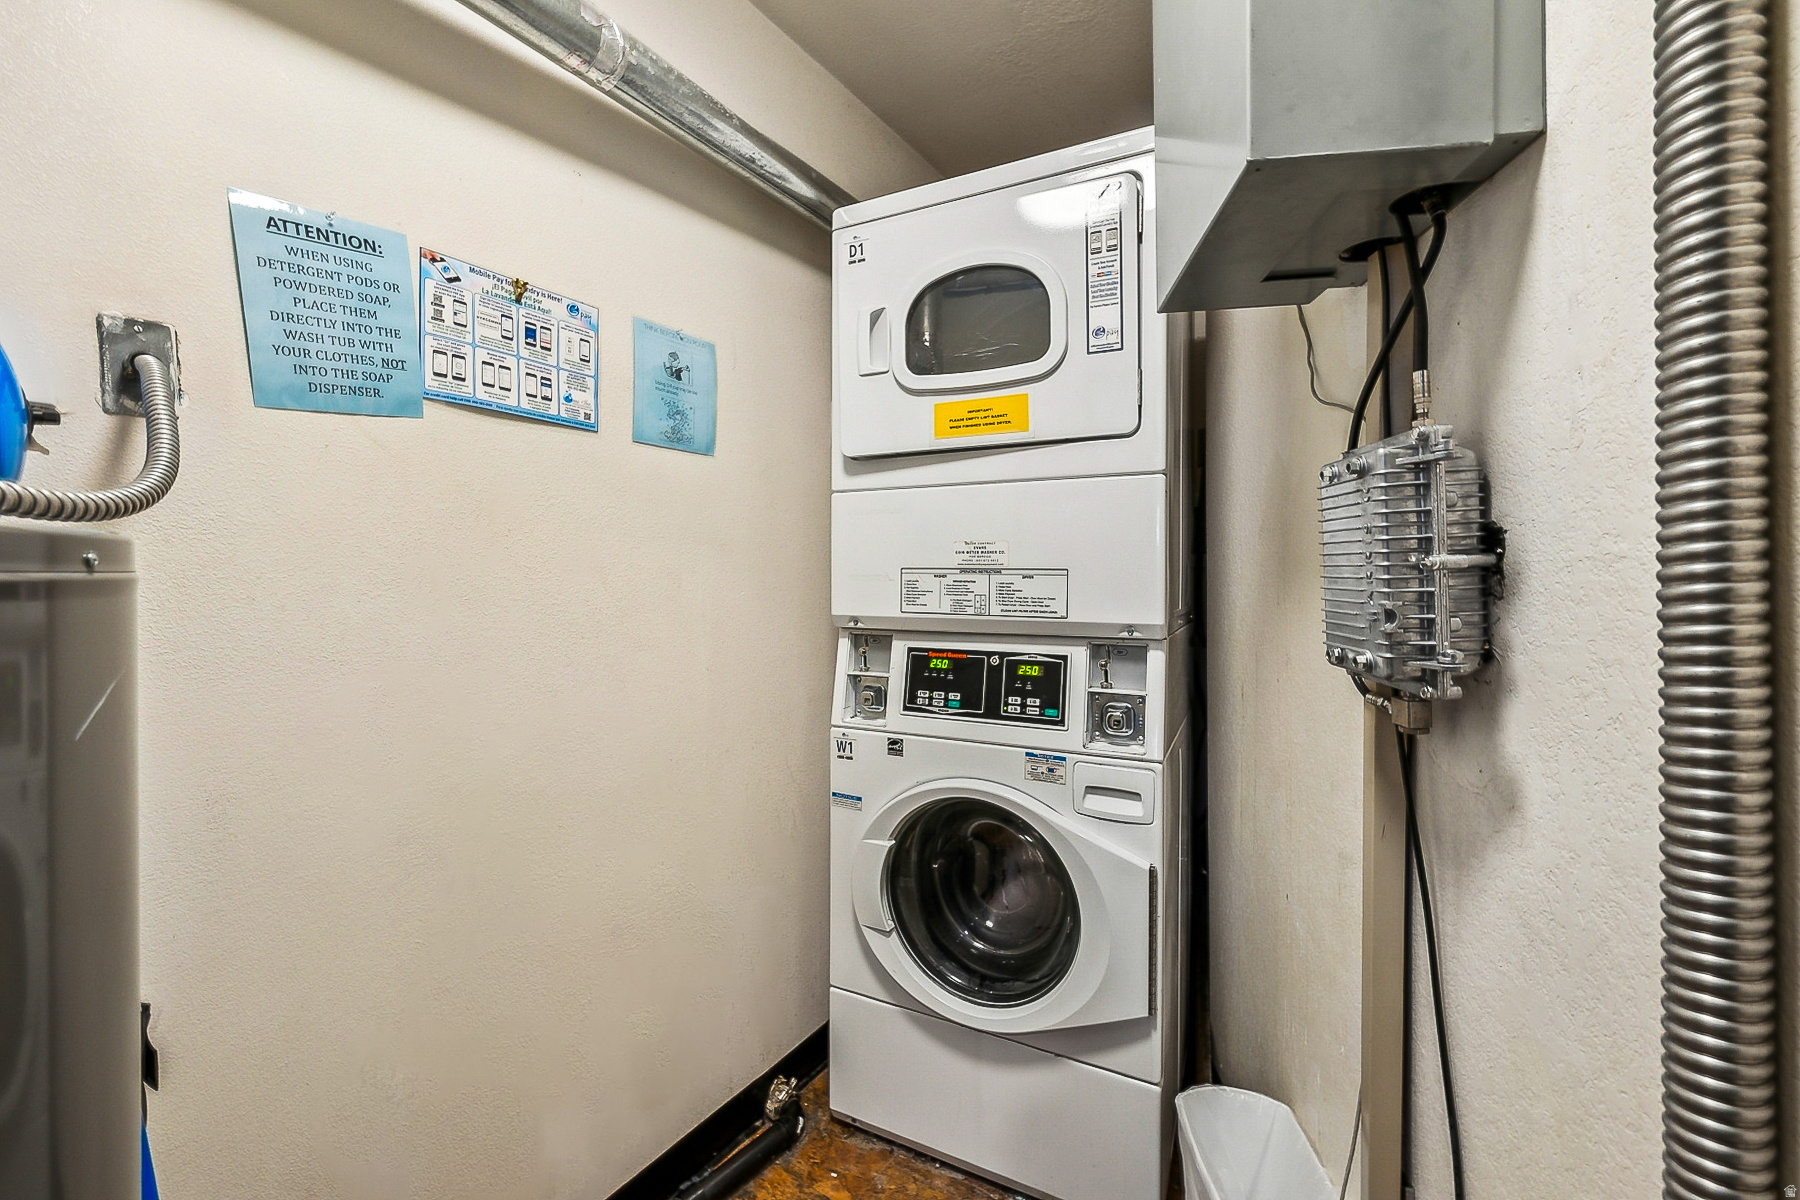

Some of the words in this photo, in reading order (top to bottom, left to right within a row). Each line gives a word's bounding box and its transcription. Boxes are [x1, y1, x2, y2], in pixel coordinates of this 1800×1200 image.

[266, 216, 384, 255] ATTENTION:
[284, 245, 329, 266] WHEN
[333, 256, 373, 272] USING
[849, 242, 863, 258] D1
[256, 256, 343, 282] DETERGENT
[347, 274, 380, 290] PODS
[383, 282, 401, 294] OR
[469, 266, 491, 280] Mobile
[492, 274, 504, 286] Pay
[548, 293, 562, 304] Here!
[273, 276, 354, 300] POWDERED
[357, 292, 392, 308] SOAP,
[481, 287, 489, 296] La
[293, 297, 337, 314] PLACE
[340, 305, 378, 320] THEM
[269, 310, 338, 330] DIRECTLY
[341, 321, 373, 335] INTO
[375, 327, 402, 340] THE
[283, 328, 325, 345] WASH
[328, 336, 356, 348] TUB
[358, 340, 394, 354] WITH
[272, 345, 312, 360] YOUR
[315, 350, 378, 368] CLOTHES,
[381, 358, 407, 372] NOT
[293, 364, 328, 378] INTO
[331, 368, 358, 381] THE
[361, 371, 394, 384] SOAP
[308, 382, 384, 398] DISPENSER.
[930, 659, 948, 668] 250
[1018, 665, 1039, 676] 250
[836, 740, 853, 754] W1
